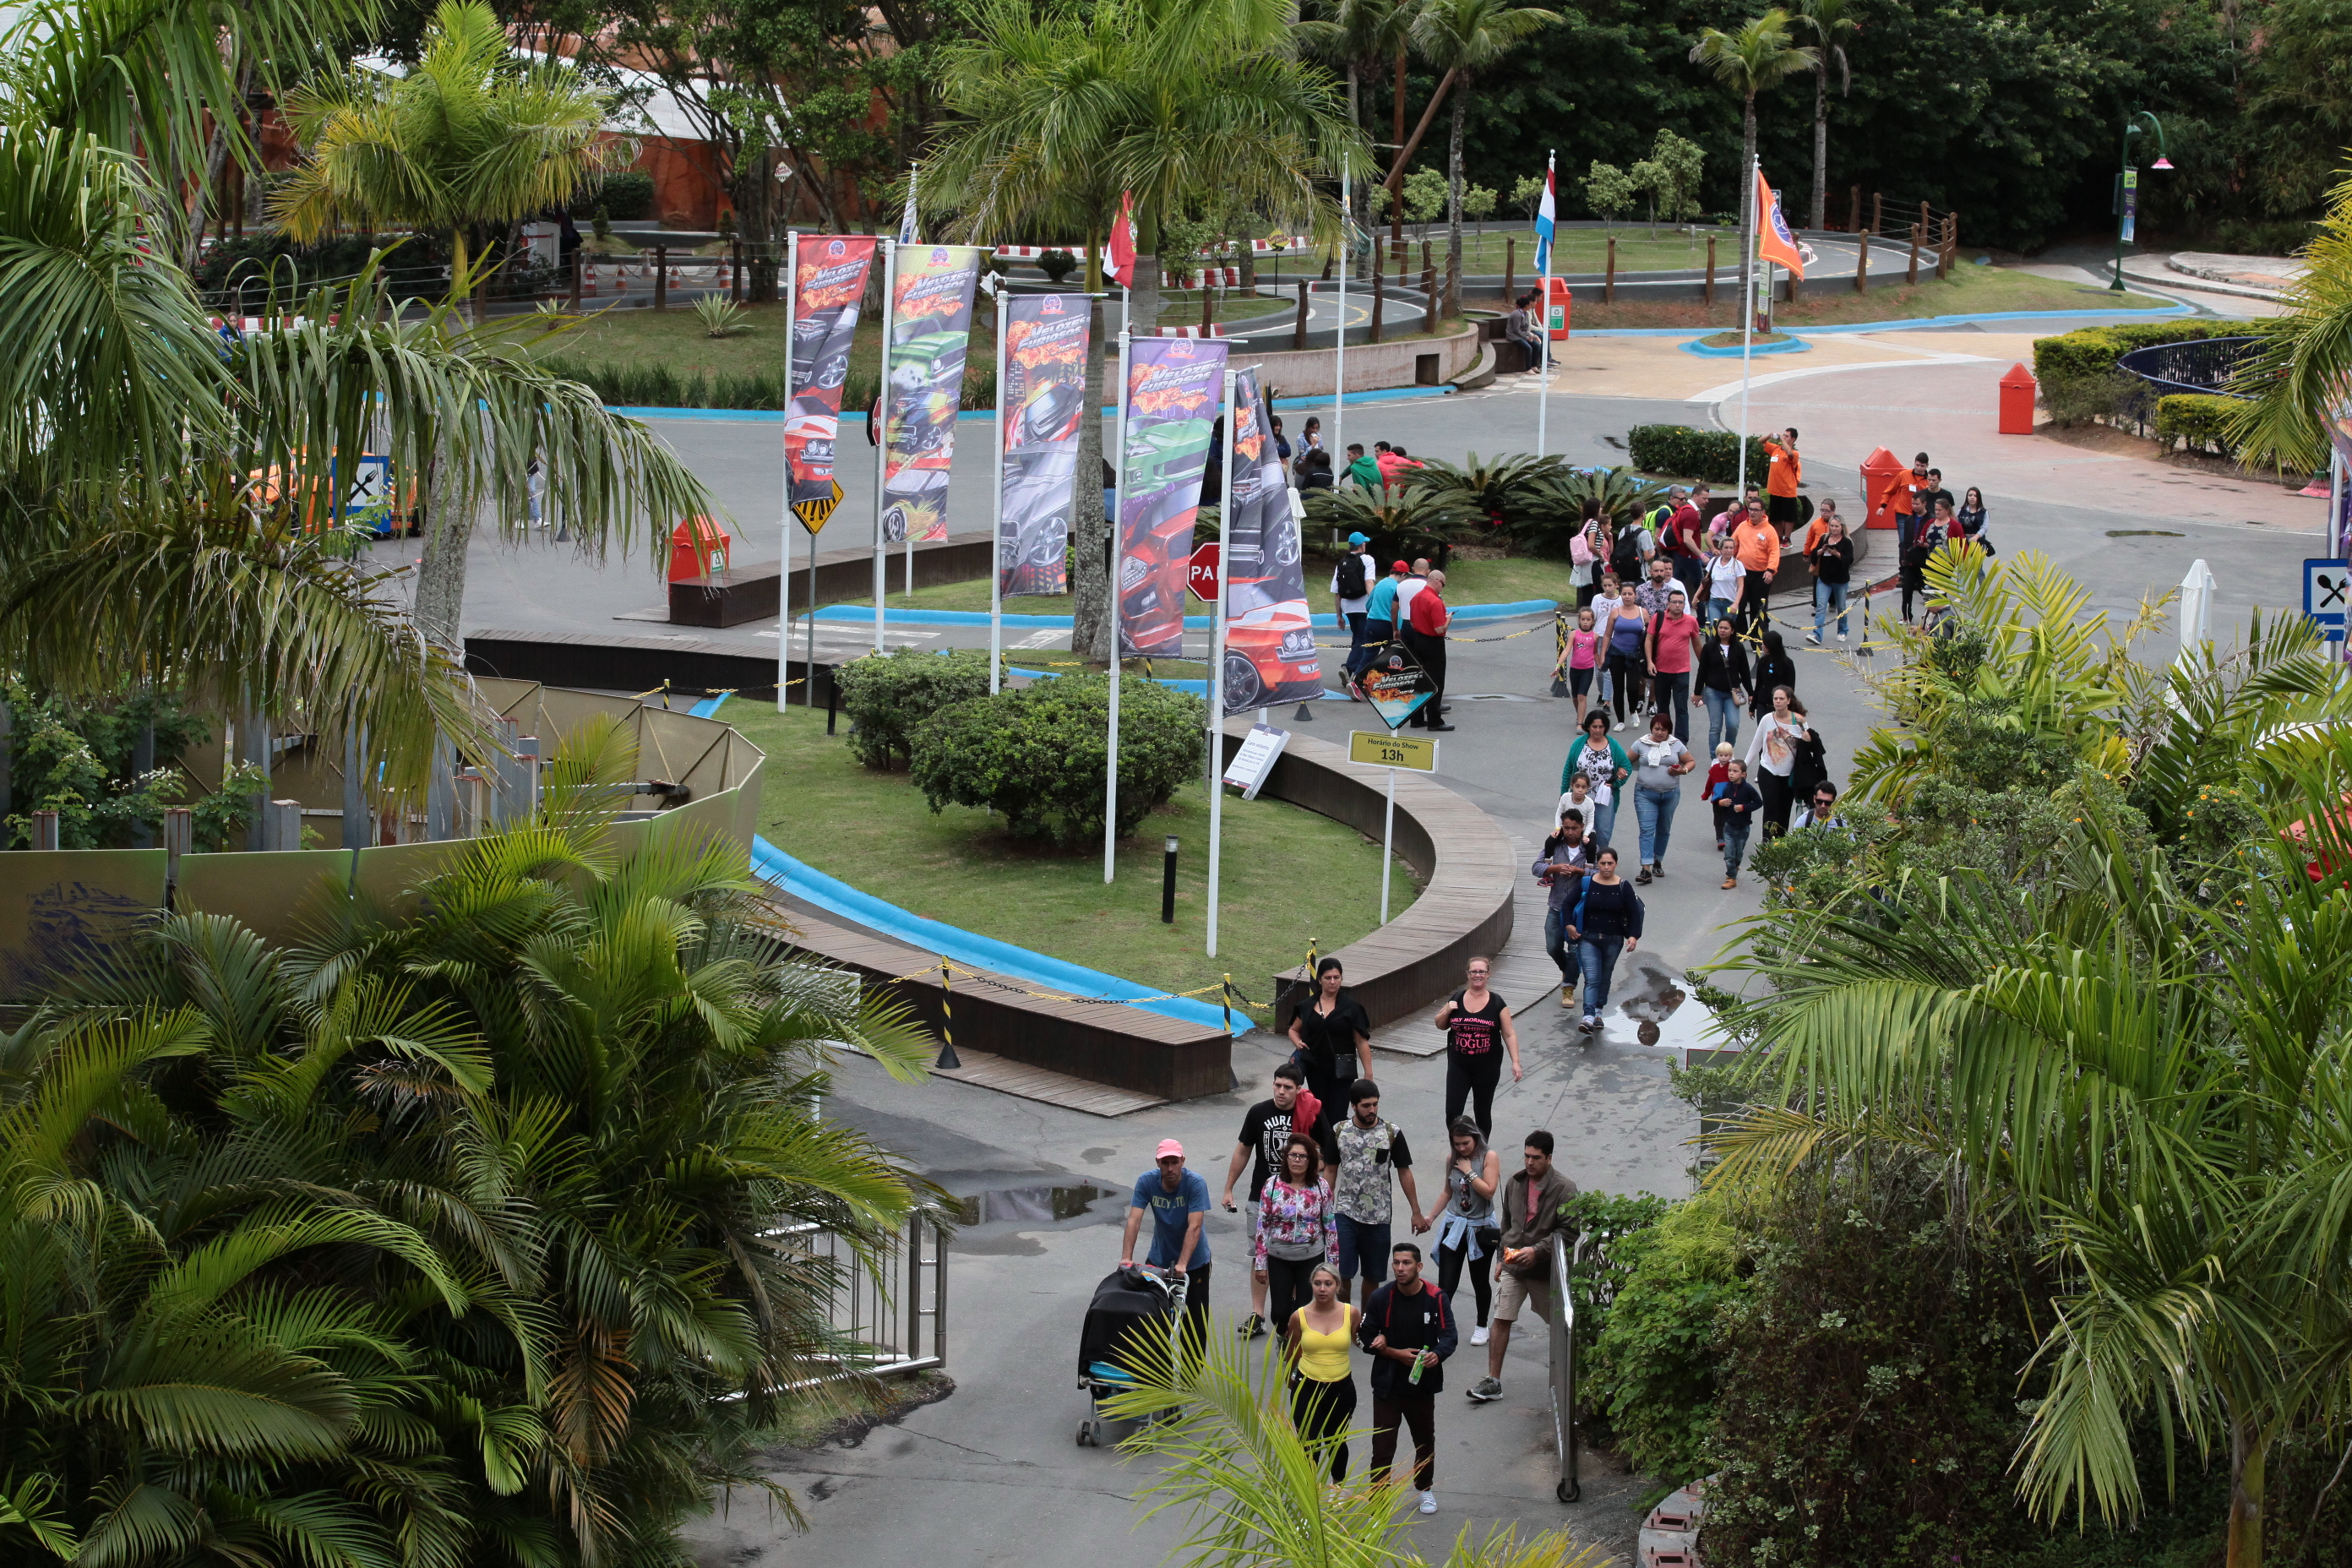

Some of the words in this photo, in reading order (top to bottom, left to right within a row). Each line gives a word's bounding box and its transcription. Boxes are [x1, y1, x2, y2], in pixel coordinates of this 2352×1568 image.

[815, 261, 864, 280] VELOZES
[916, 270, 972, 290] VELOZES
[803, 270, 860, 293] FURIOSOS
[901, 280, 966, 304] FURIOSOS
[1031, 316, 1086, 338] VELOZES
[1016, 326, 1082, 352] FURIOSOS
[1152, 362, 1219, 383] VELOZES
[1134, 371, 1211, 396] FURIOSOS
[1191, 565, 1219, 580] PA
[1372, 679, 1415, 691] FURIOSOS
[1381, 673, 1418, 683] VELOZES
[1368, 738, 1391, 747] Horário
[1381, 749, 1404, 761] 13h
[1456, 1036, 1491, 1048] VOGUE
[1264, 1115, 1292, 1130] HURL
